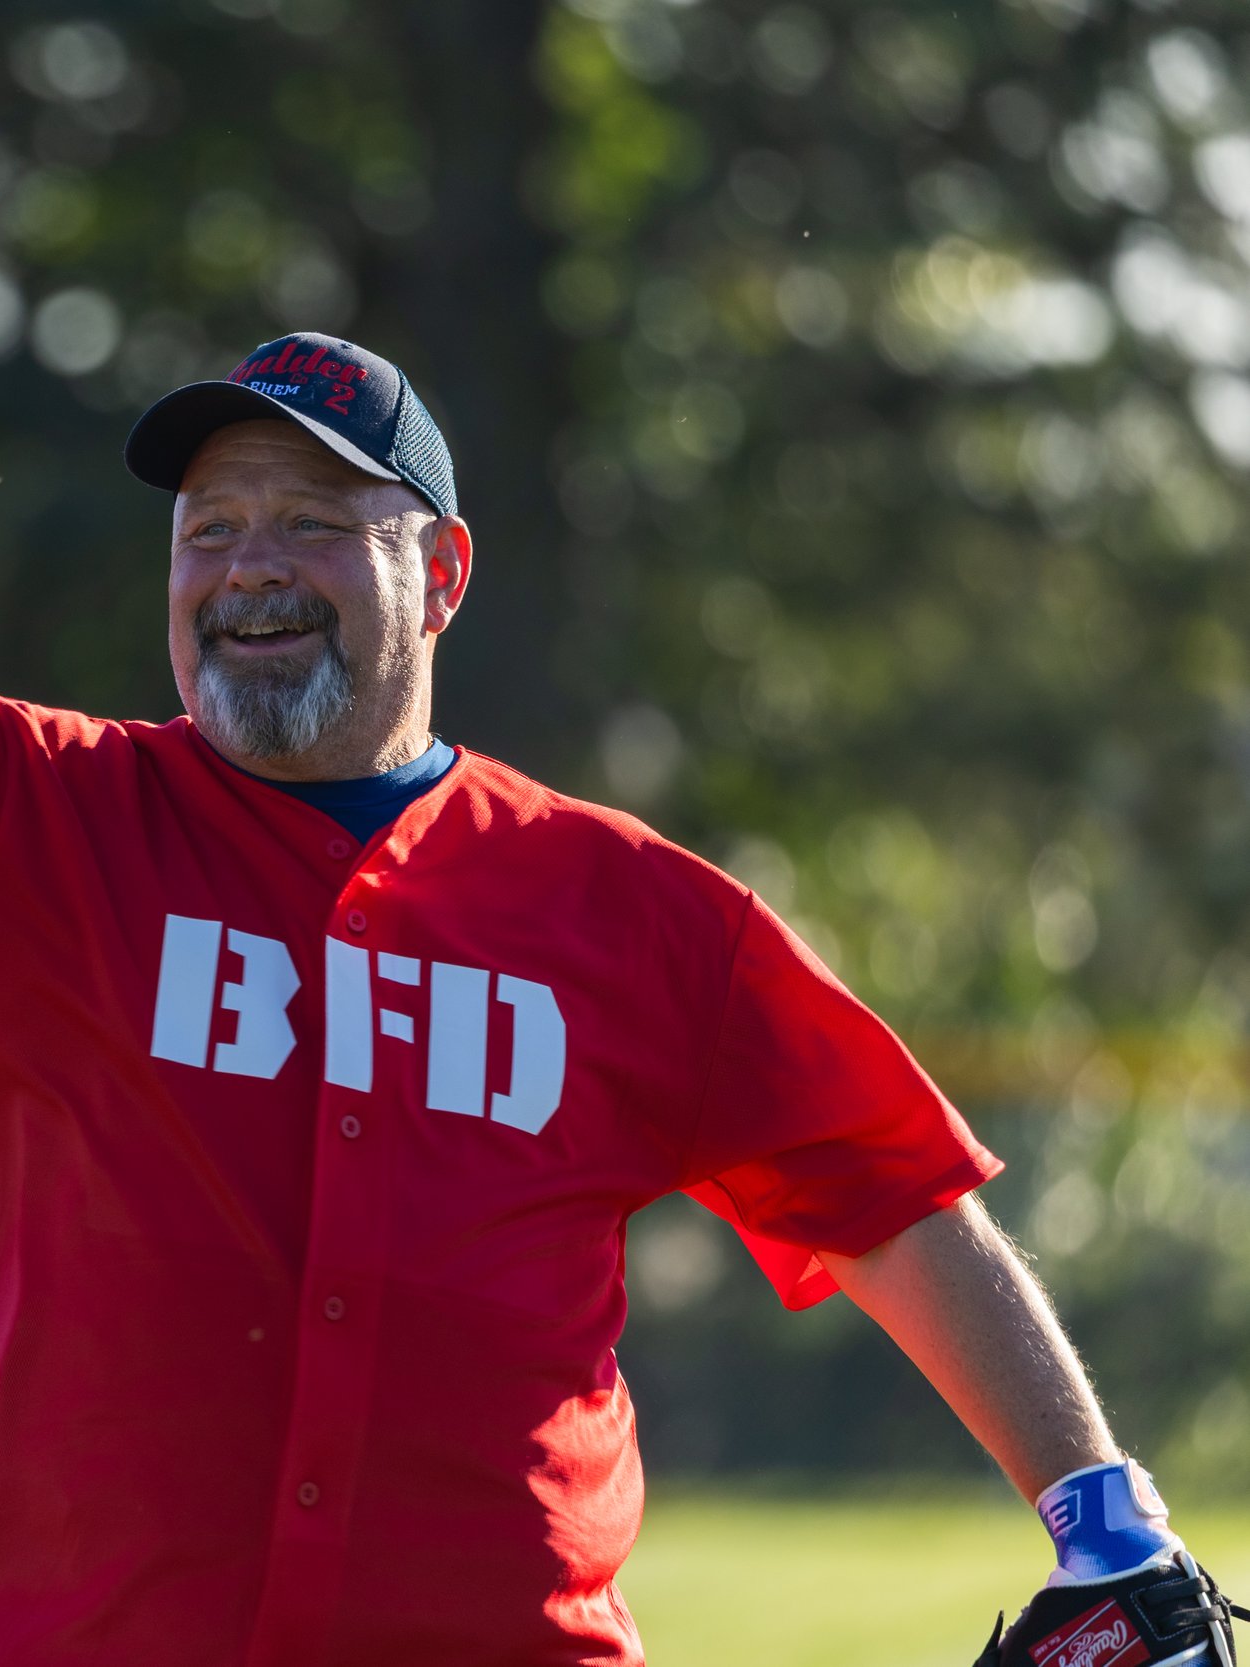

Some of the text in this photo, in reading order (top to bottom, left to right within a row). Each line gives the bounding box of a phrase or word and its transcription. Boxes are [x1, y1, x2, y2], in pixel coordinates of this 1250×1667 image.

[240, 381, 300, 396] EHEM
[323, 383, 356, 416] 2
[150, 913, 567, 1136] BFD
[1058, 1619, 1128, 1667] Rawling
